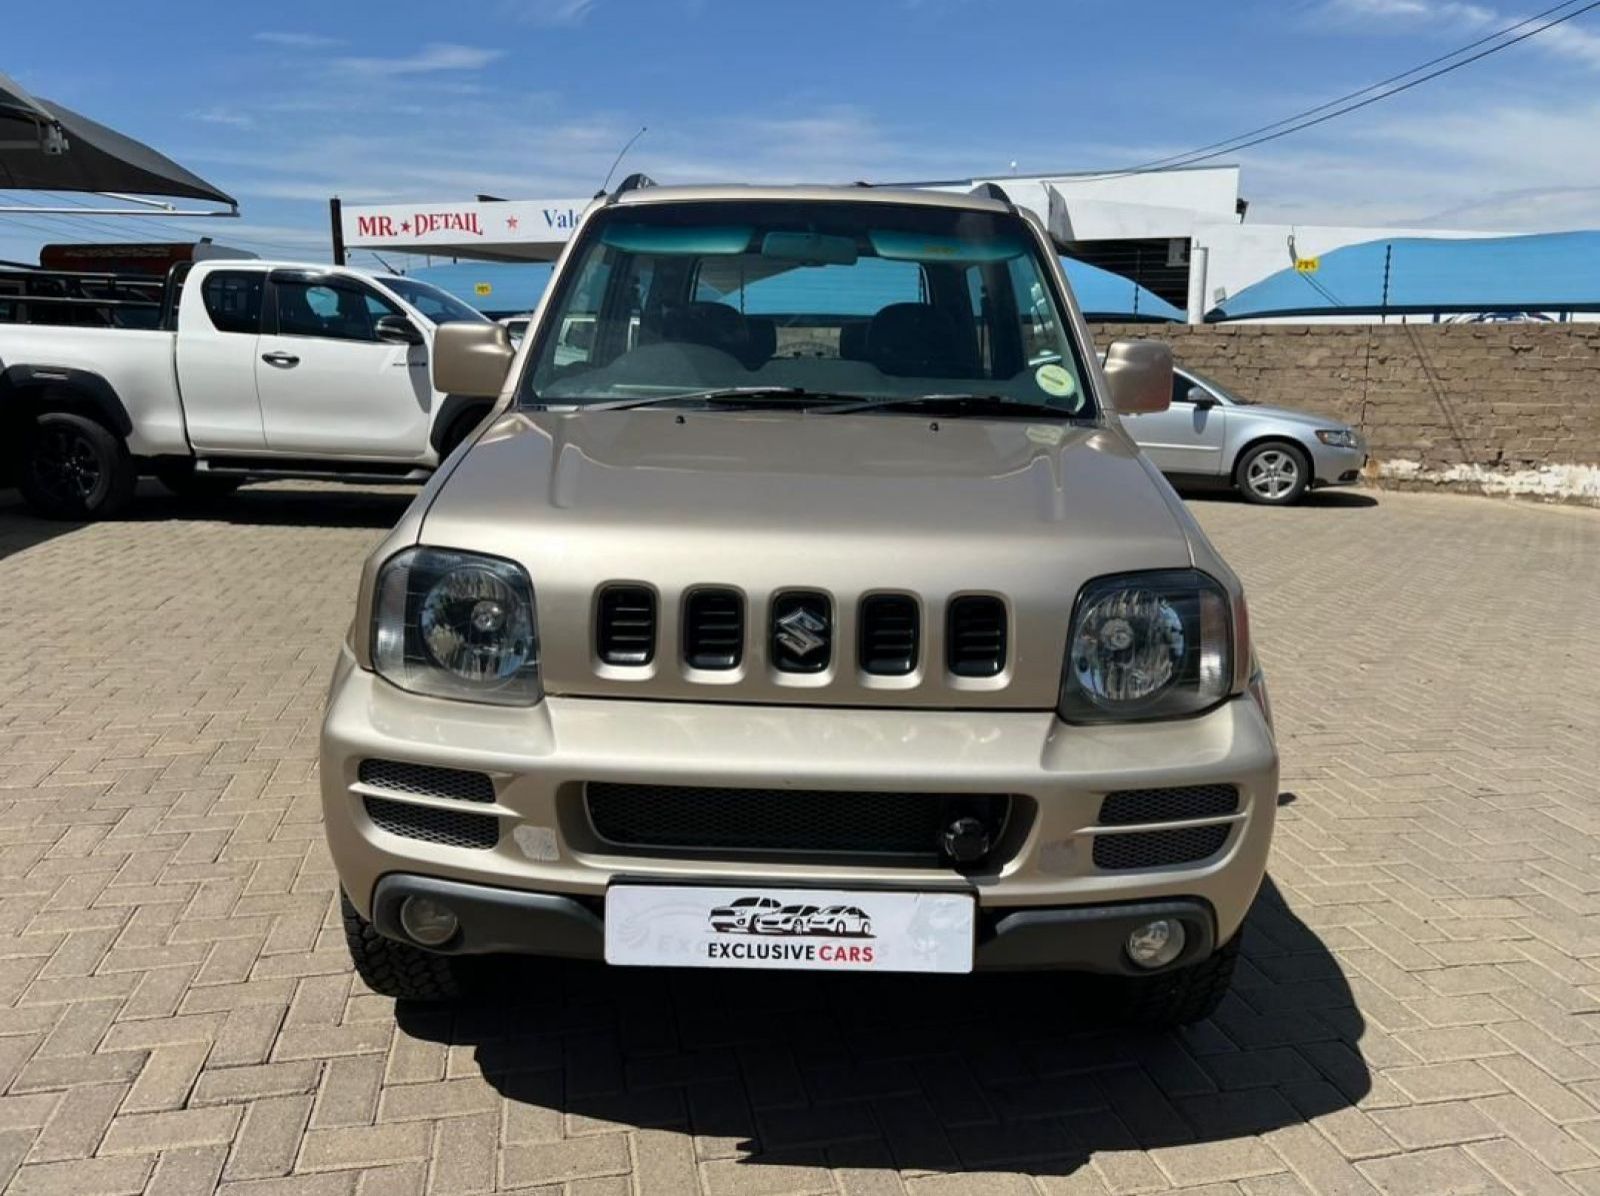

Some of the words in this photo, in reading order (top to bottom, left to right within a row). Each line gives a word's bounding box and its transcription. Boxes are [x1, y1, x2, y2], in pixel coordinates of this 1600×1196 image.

[358, 216, 398, 236] MR.
[414, 212, 484, 236] DETAIL
[708, 943, 815, 961] EXCLUSIVE
[819, 946, 874, 962] CARS
